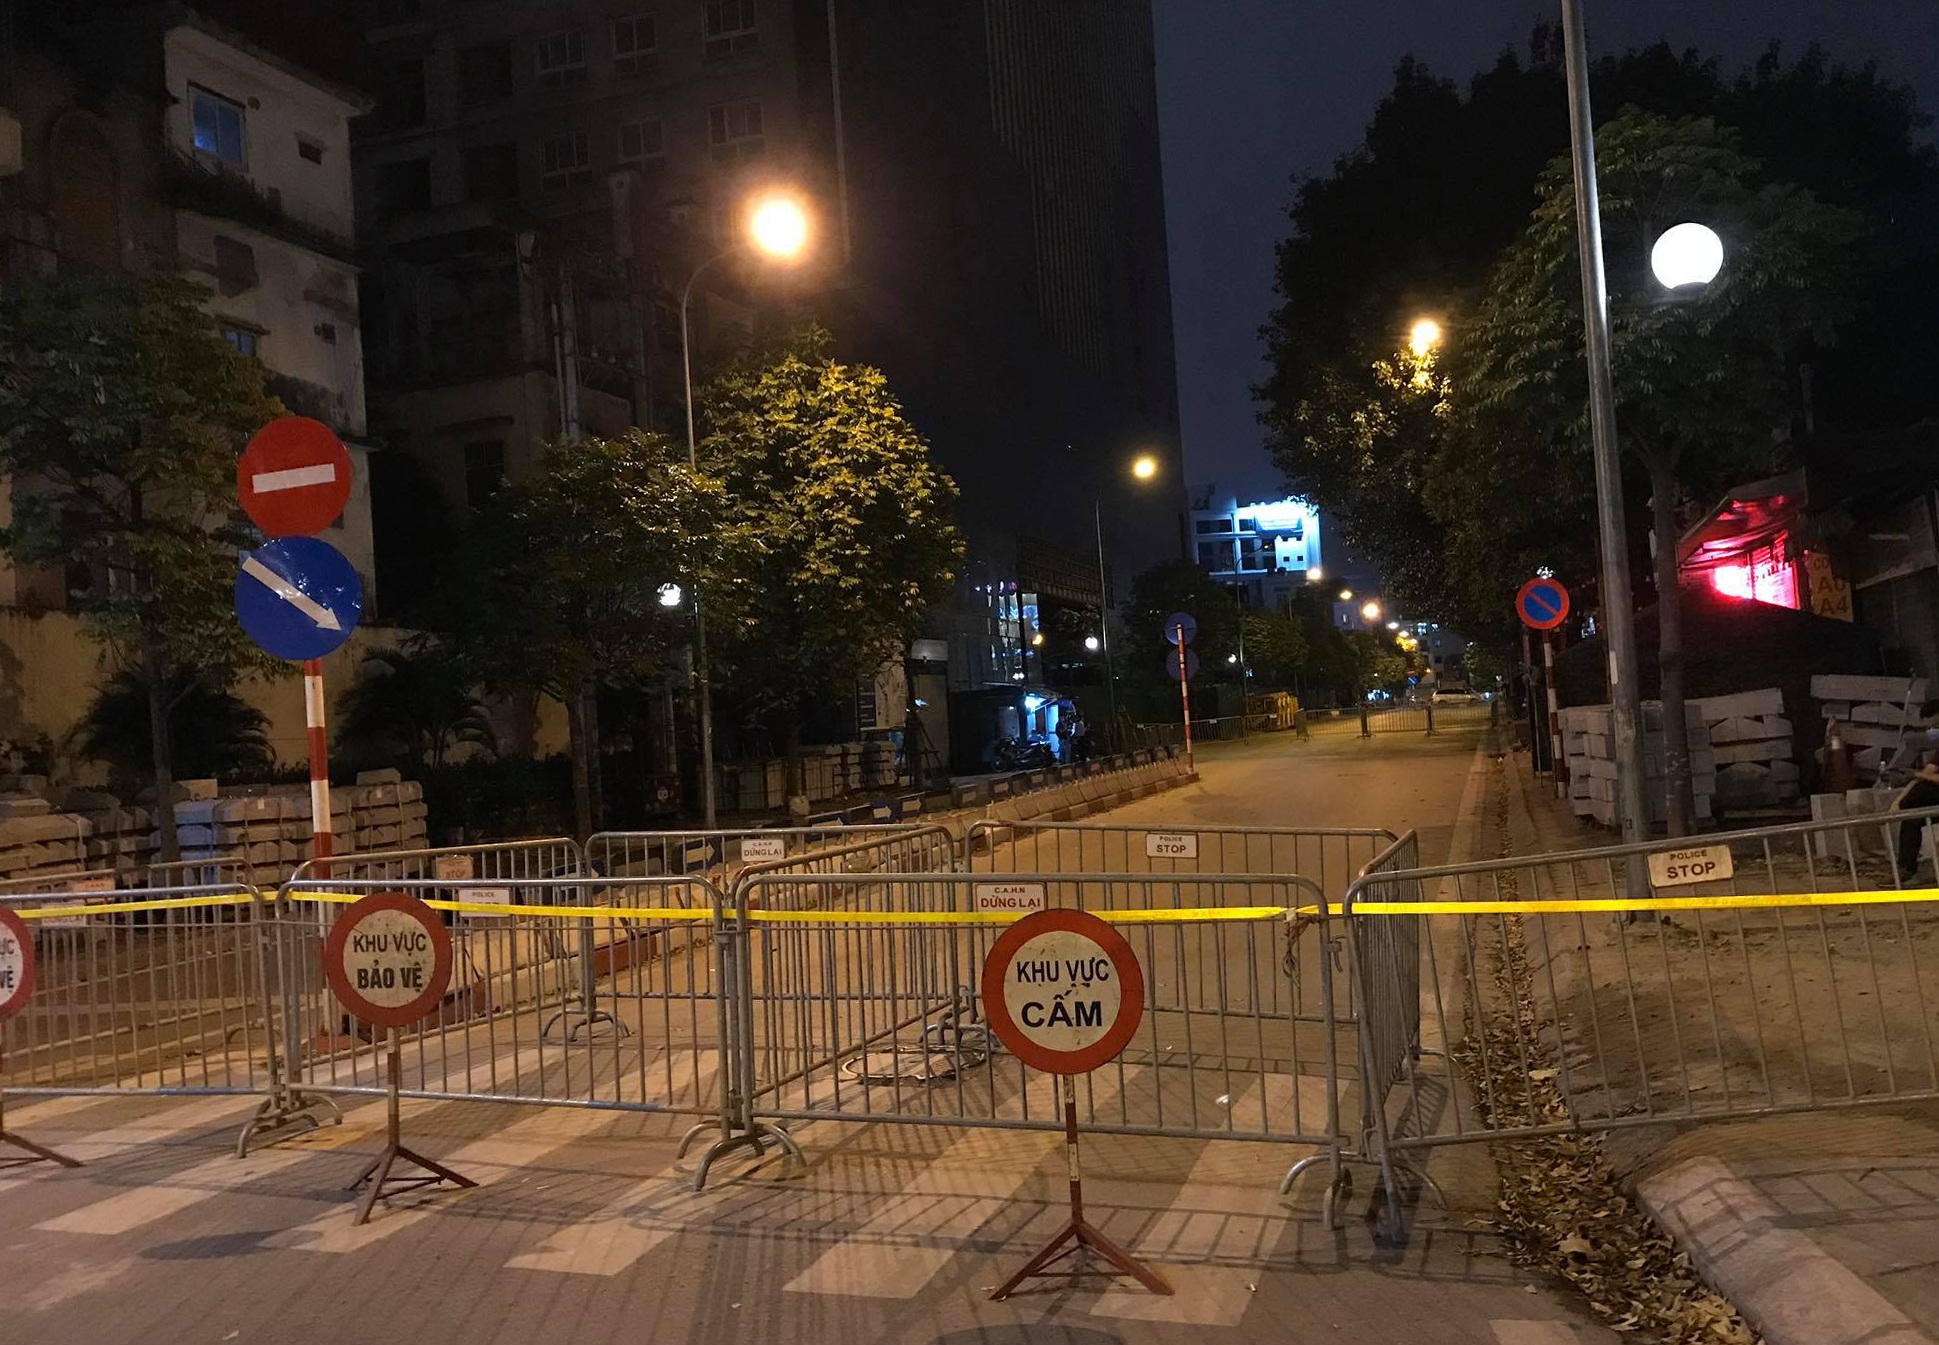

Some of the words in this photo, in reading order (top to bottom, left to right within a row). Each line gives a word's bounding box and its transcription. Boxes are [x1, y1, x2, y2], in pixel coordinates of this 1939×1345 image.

[1156, 844, 1187, 854] STOP
[1670, 849, 1708, 861] POLICE
[1667, 861, 1716, 879] STOP
[353, 934, 388, 953] KHU
[392, 931, 427, 957] VỰC
[356, 959, 395, 989] BẢO
[400, 961, 423, 993] VỆ
[1016, 960, 1059, 983] KHU
[1066, 957, 1109, 987] VỰC
[1020, 989, 1102, 1028] CẤM
